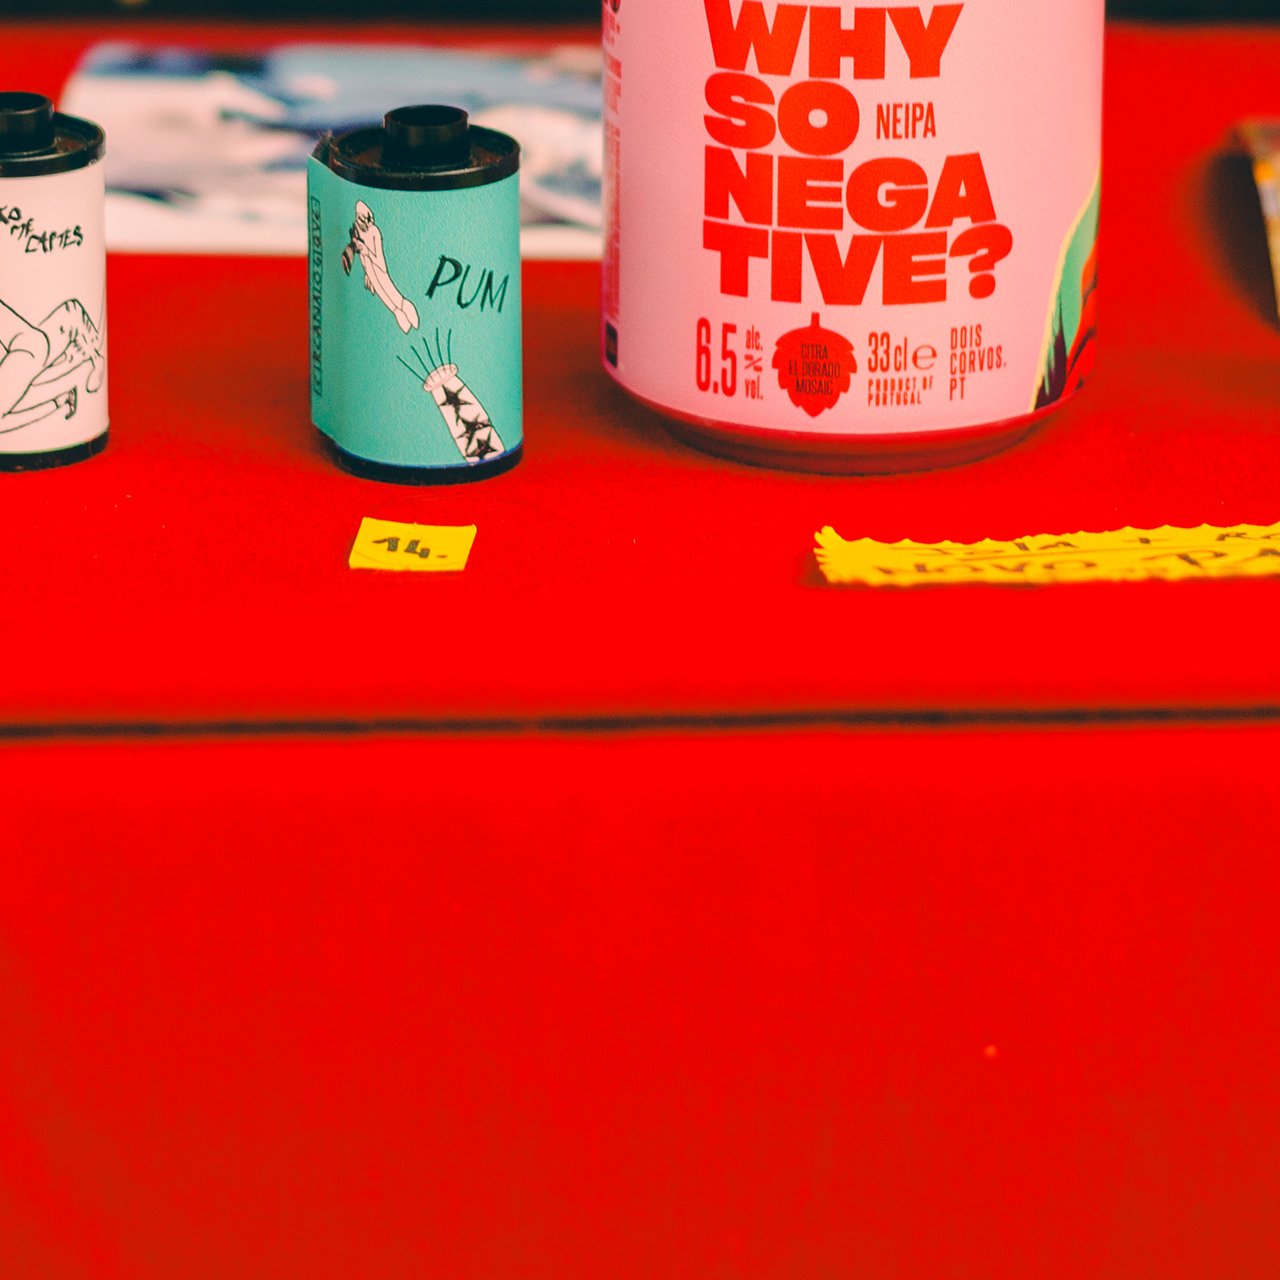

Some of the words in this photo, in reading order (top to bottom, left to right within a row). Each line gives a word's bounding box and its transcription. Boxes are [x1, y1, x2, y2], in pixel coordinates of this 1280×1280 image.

[703, 71, 859, 156] SO
[876, 102, 936, 139] NEIPA
[703, 144, 997, 233] NEGA
[702, 219, 1013, 306] TIVE?
[425, 255, 510, 314] PUM
[745, 324, 763, 351] alc.
[950, 323, 982, 351] DOIS
[696, 317, 737, 397] 6.5
[801, 343, 828, 360] CITRA
[950, 345, 1007, 376] CORVOS.
[789, 360, 799, 376] EL
[802, 361, 840, 378] DORADO
[745, 375, 763, 400] vol.
[796, 378, 833, 395] MOSAIC
[868, 376, 917, 392] PRODUCT
[922, 375, 934, 391] OF
[950, 376, 966, 401] PT
[868, 391, 921, 406] PORTUGAL
